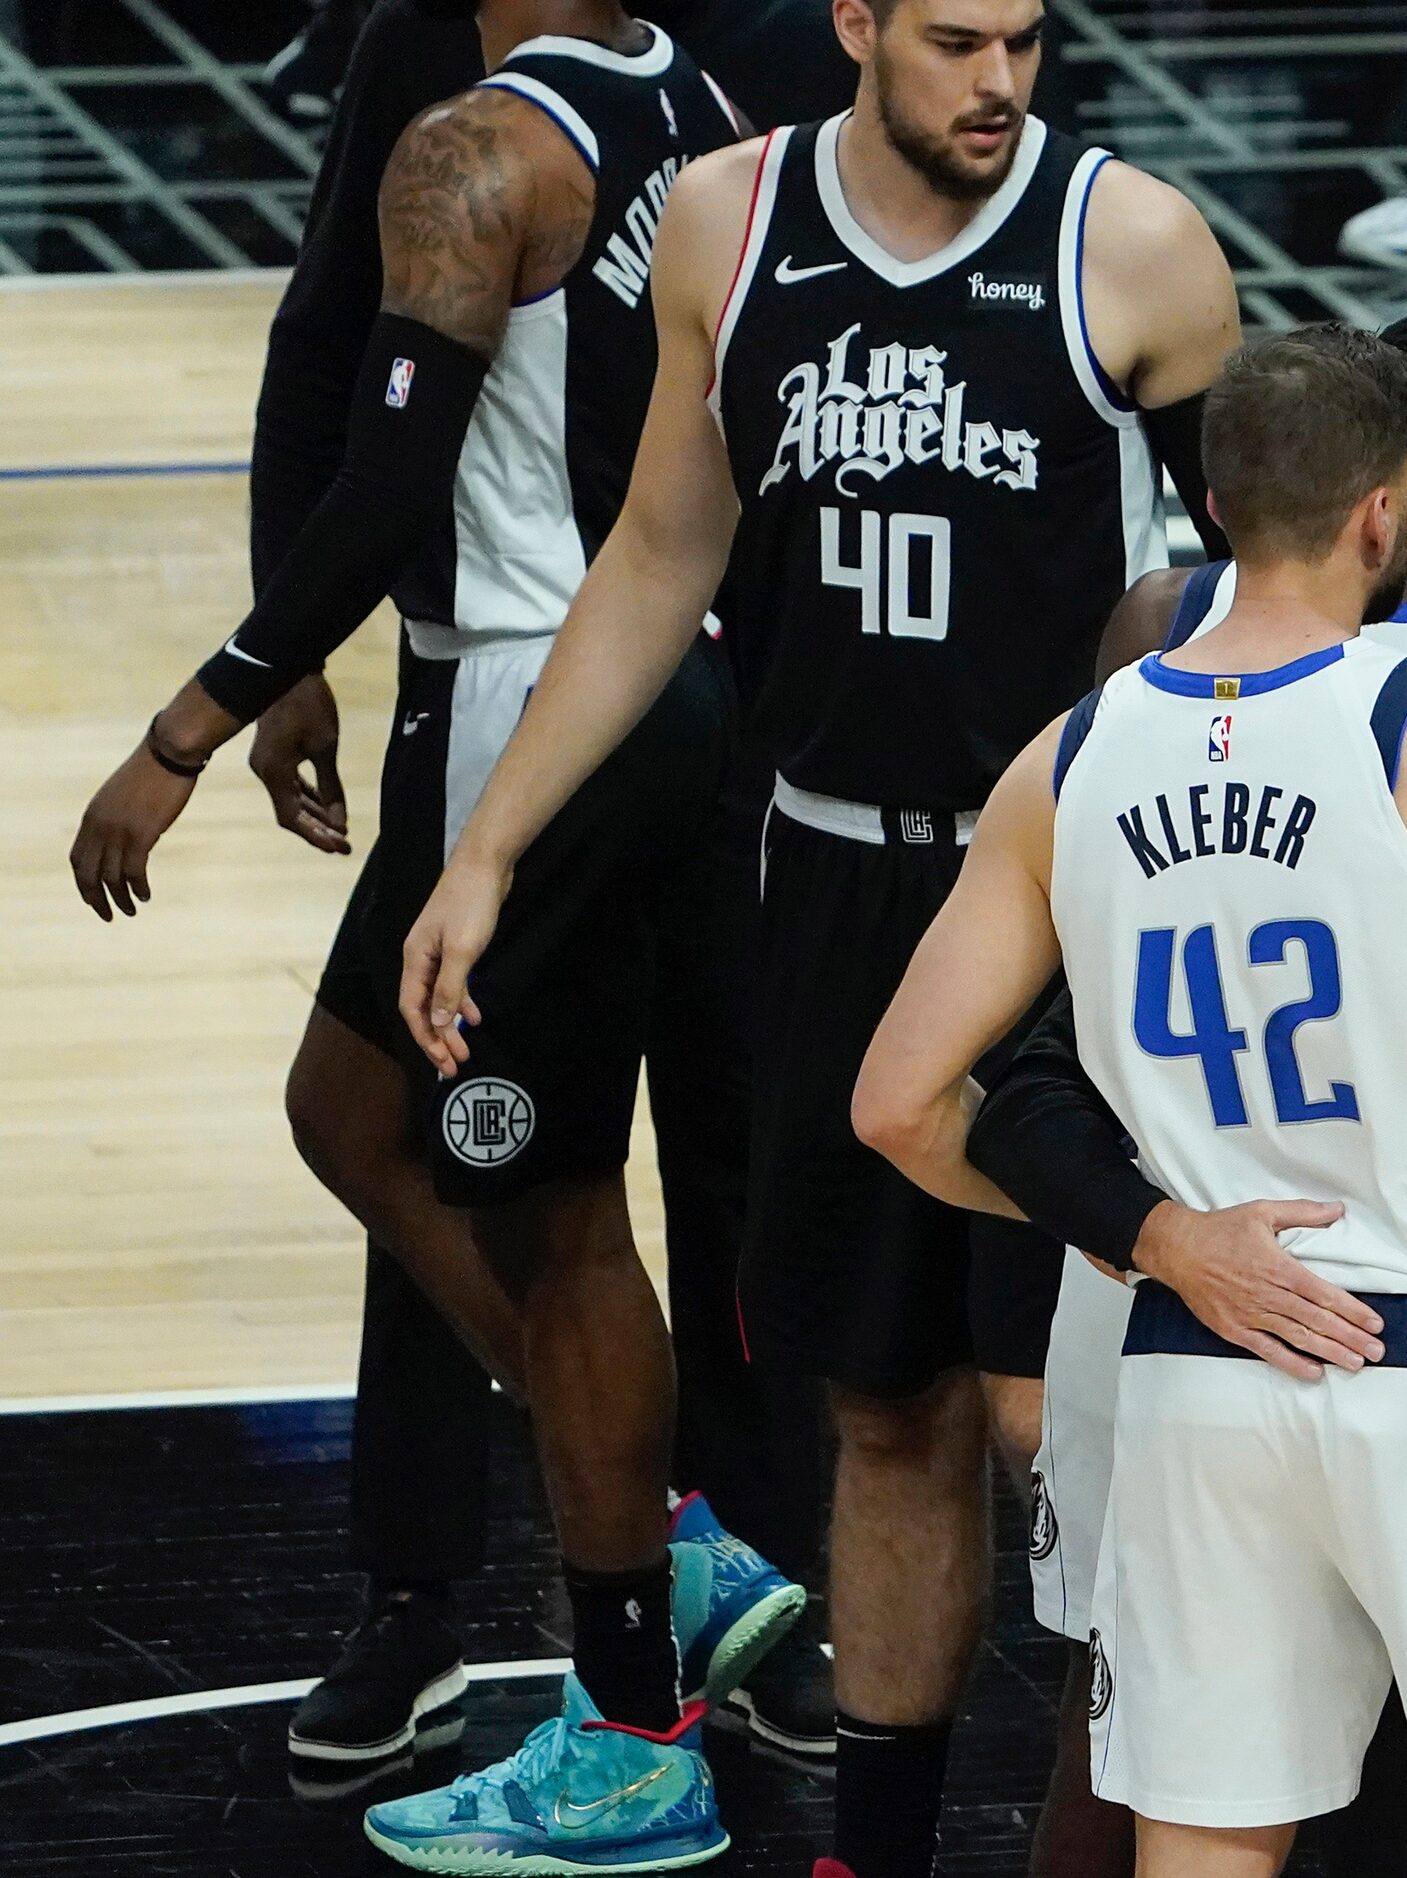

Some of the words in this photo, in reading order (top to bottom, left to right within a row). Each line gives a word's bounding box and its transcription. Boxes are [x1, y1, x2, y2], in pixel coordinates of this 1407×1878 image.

[968, 272, 1045, 309] honey
[817, 322, 948, 406] Los
[759, 362, 1041, 498] Angeles
[820, 506, 951, 641] 40
[1116, 782, 1317, 880] KLEBER
[1131, 916, 1362, 1130] 42
